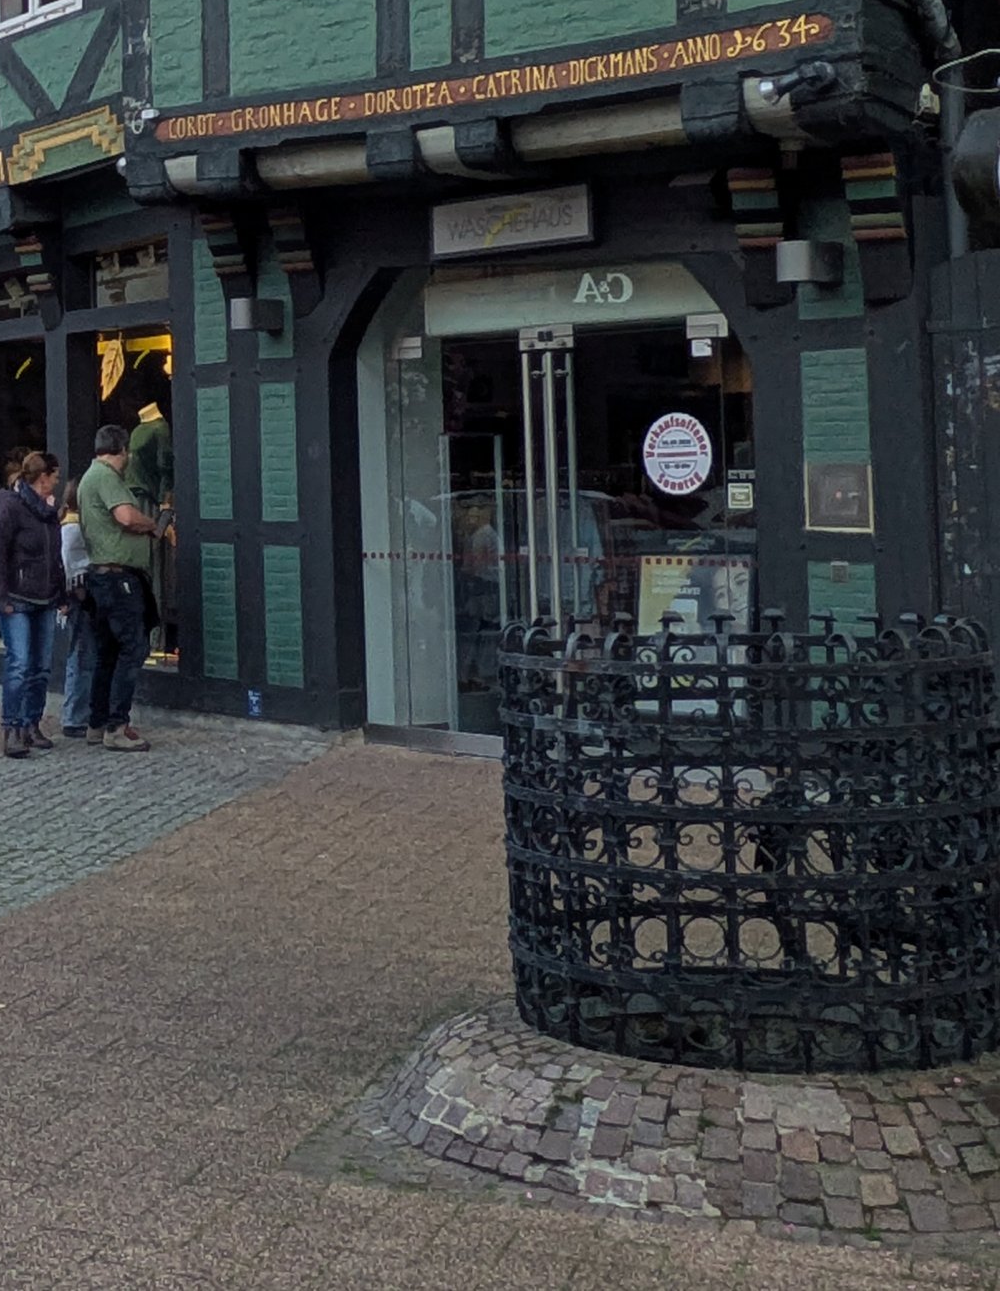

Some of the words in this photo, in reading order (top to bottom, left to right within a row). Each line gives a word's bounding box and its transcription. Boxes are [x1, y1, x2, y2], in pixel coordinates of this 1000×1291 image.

[231, 96, 341, 132] GRONHAGE
[364, 80, 453, 117] DOROTEA
[472, 64, 559, 100] CATRINA
[569, 44, 658, 85] DICKMANS
[670, 33, 721, 68] ANNO
[645, 415, 709, 459] Verkaufsoffener
[656, 470, 704, 491] Sonntag
